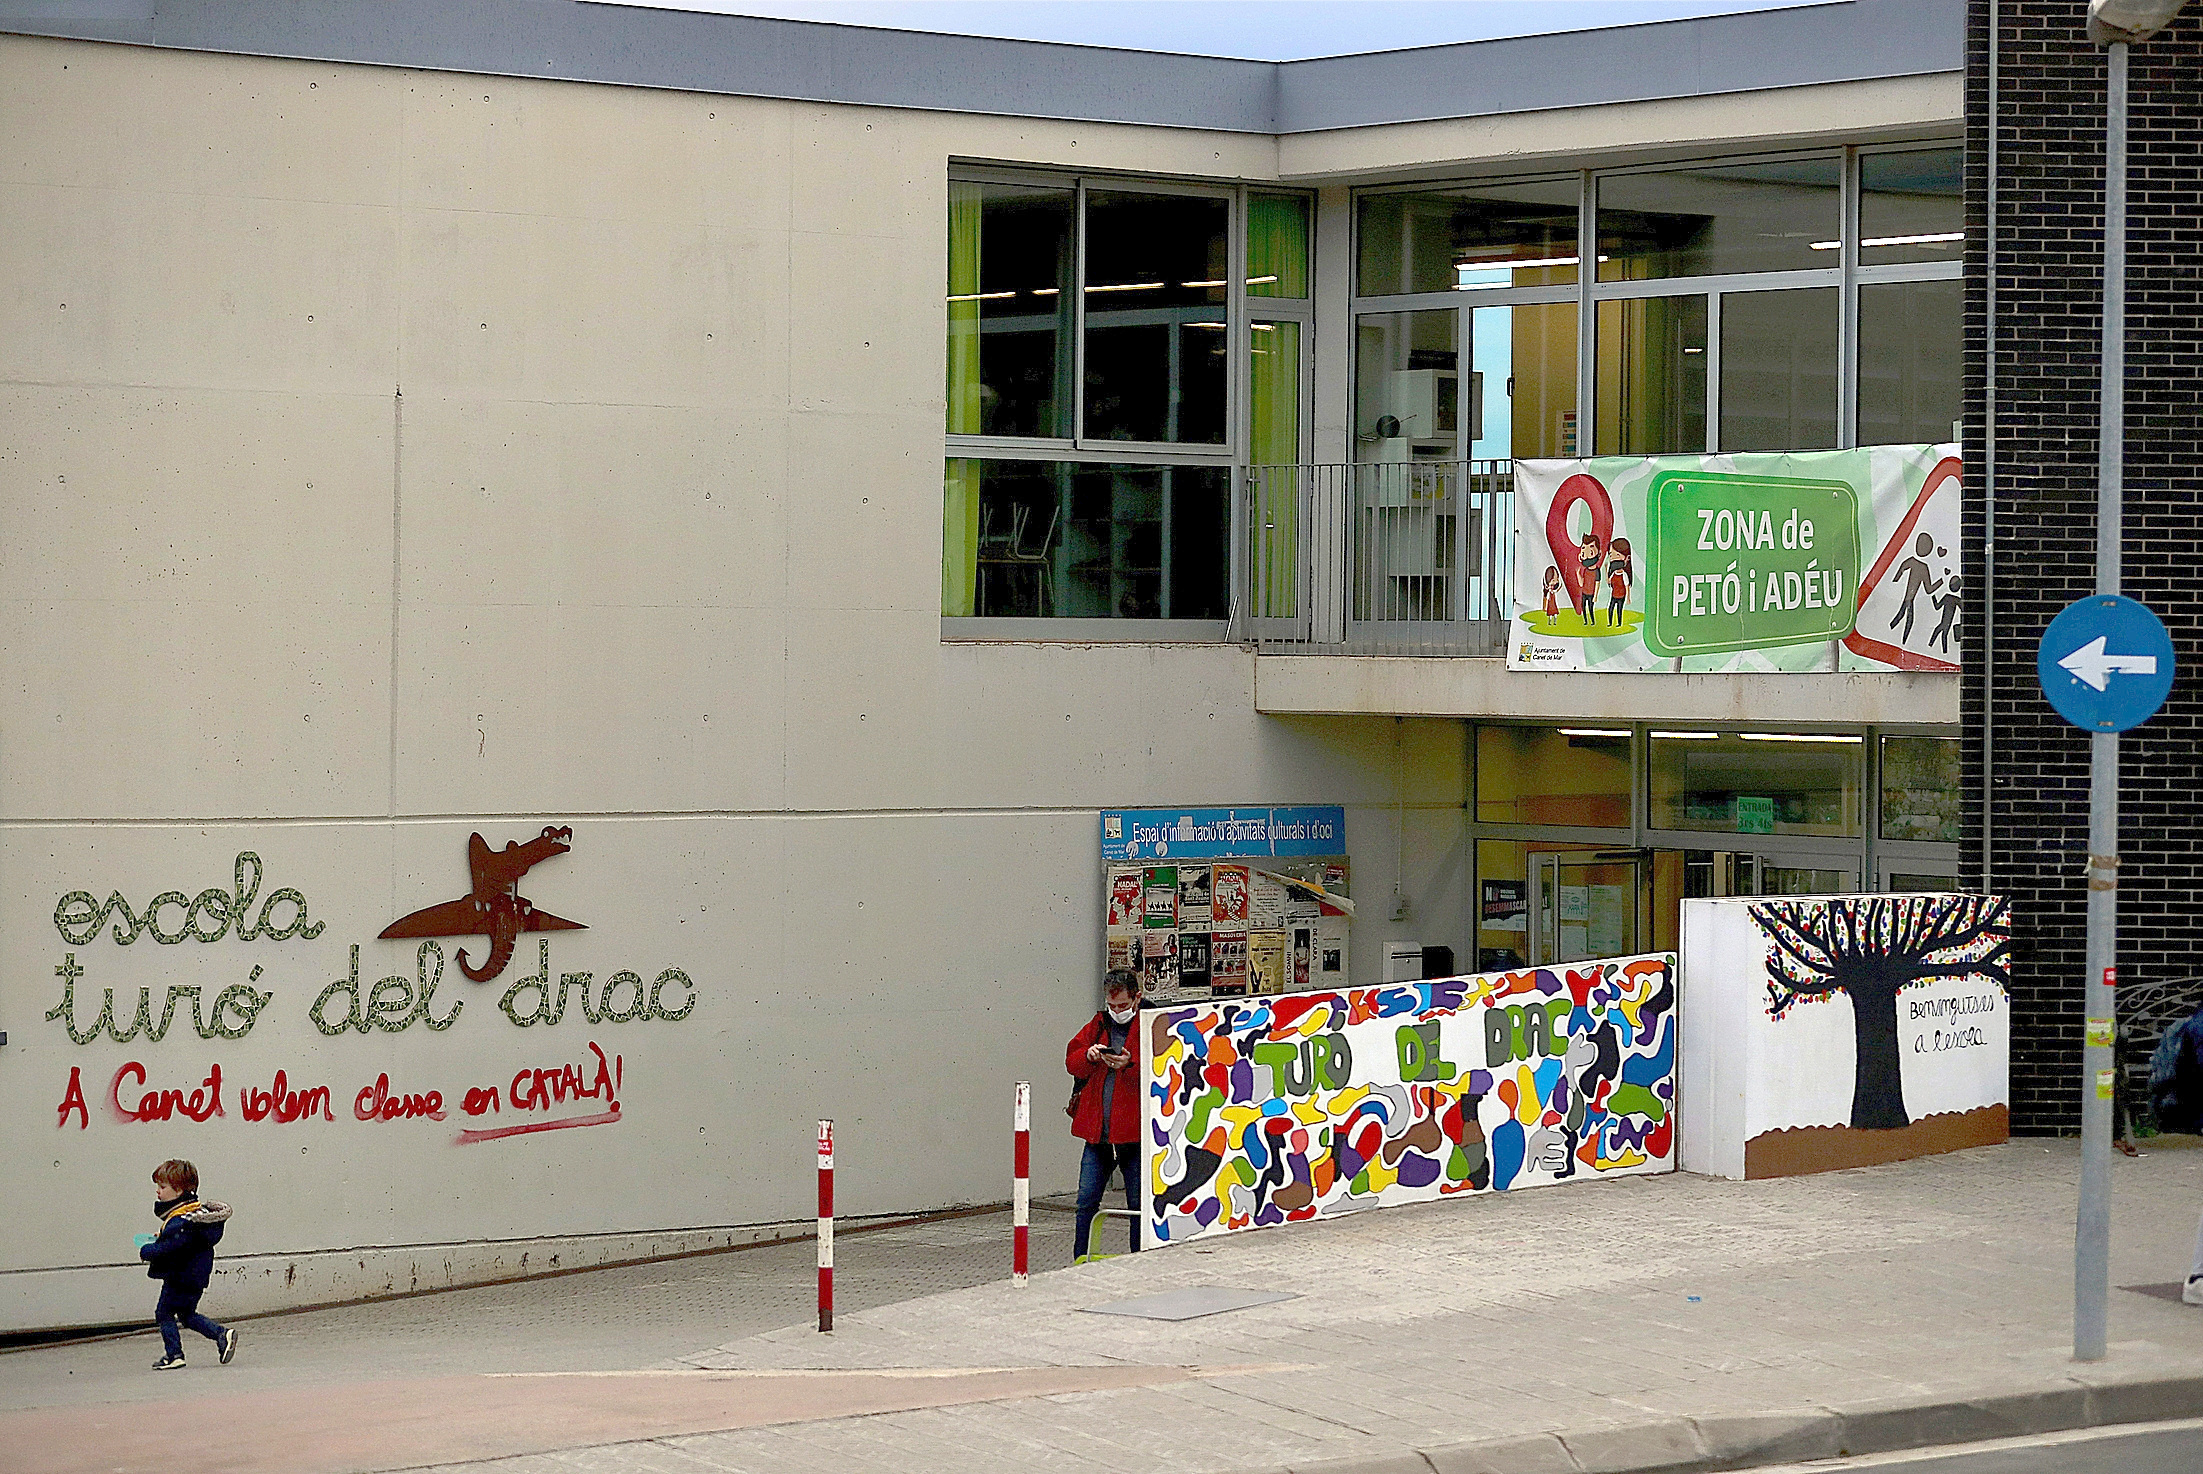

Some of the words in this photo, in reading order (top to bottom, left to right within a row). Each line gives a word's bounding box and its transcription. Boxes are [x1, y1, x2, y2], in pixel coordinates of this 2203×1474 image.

[1697, 509, 1775, 551] ZONA
[1781, 508, 1814, 550] de
[1672, 559, 1742, 617] PETÓ
[1749, 568, 1756, 612] i
[1762, 558, 1843, 612] ADÉU
[1133, 822, 1159, 847] Espai
[1267, 819, 1305, 840] culturals
[1306, 820, 1310, 839] i
[1311, 819, 1333, 840] d'oci
[1739, 803, 1772, 812] ENTRADA
[54, 850, 327, 945] escola
[45, 952, 274, 1045] turó
[308, 940, 464, 1036] del
[497, 937, 698, 1026] drac
[1396, 1019, 1457, 1082] DEL
[1485, 998, 1573, 1068] DRAC
[1914, 1034, 1928, 1054] a
[58, 1066, 90, 1130] A
[104, 1061, 226, 1124] Canet
[240, 1069, 337, 1124] volem
[459, 1086, 501, 1116] en
